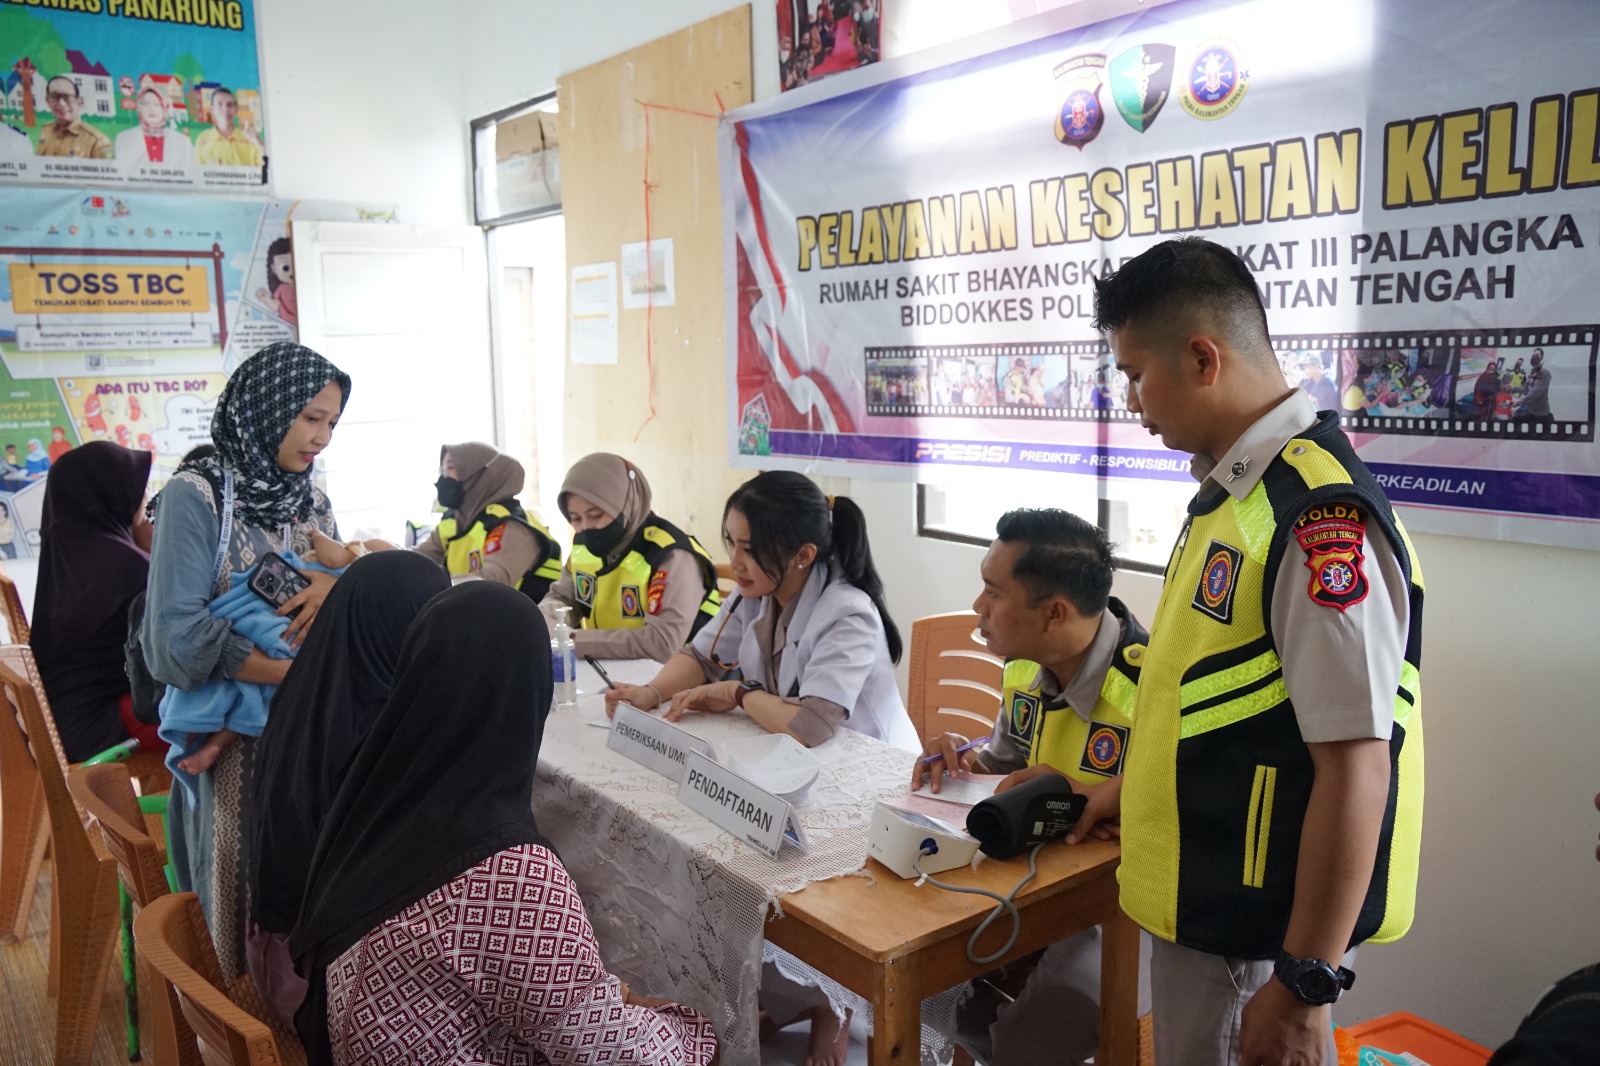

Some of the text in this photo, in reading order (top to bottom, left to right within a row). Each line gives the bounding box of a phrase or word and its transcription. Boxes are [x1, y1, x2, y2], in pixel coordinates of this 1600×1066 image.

[107, 0, 244, 31] PANARUNG
[796, 87, 1600, 271] PELAYANAN KESEHATAN KELIL
[819, 278, 888, 304] RUMAH
[896, 272, 960, 298] SAKIT
[1237, 240, 1299, 272] KAT
[1312, 237, 1337, 268] III
[1350, 213, 1584, 265] PALANGKA
[38, 272, 184, 295] TOSS TBC
[901, 264, 1516, 327] BIDDOKKES POL NTAN TENGAH
[95, 380, 208, 395] APA ITU TBC RO?
[915, 442, 1012, 464] PRESISI
[1019, 449, 1081, 465] PREDIKTIF
[1089, 455, 1193, 473] RESPONSIBILIT
[1371, 473, 1486, 496] RKEADILAN
[1298, 506, 1360, 527] POLDA
[1303, 530, 1359, 545] KALIMANTAN TENGAH
[615, 721, 668, 756] PEMERIKSAAN
[687, 769, 773, 833] PENDAFTARAN
[1046, 800, 1071, 811] OMRON
